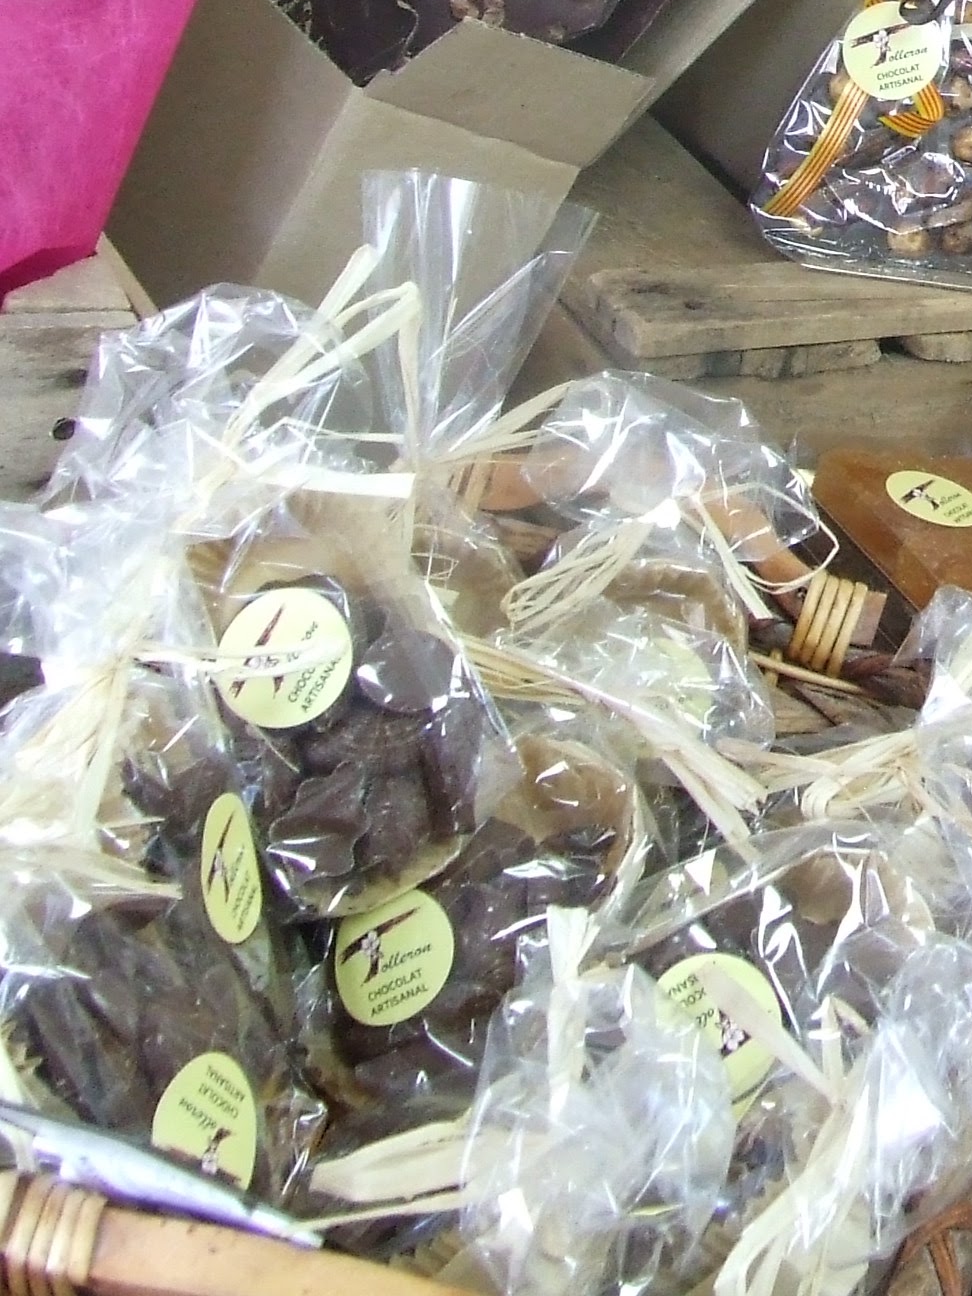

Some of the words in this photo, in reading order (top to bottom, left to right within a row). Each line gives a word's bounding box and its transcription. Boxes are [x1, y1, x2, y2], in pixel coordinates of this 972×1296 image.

[876, 63, 921, 81] CHOCOLAT
[878, 74, 925, 92] ARTISANAL
[367, 967, 423, 1002] CHOCOLAT
[370, 983, 429, 1018] ARTISANAL
